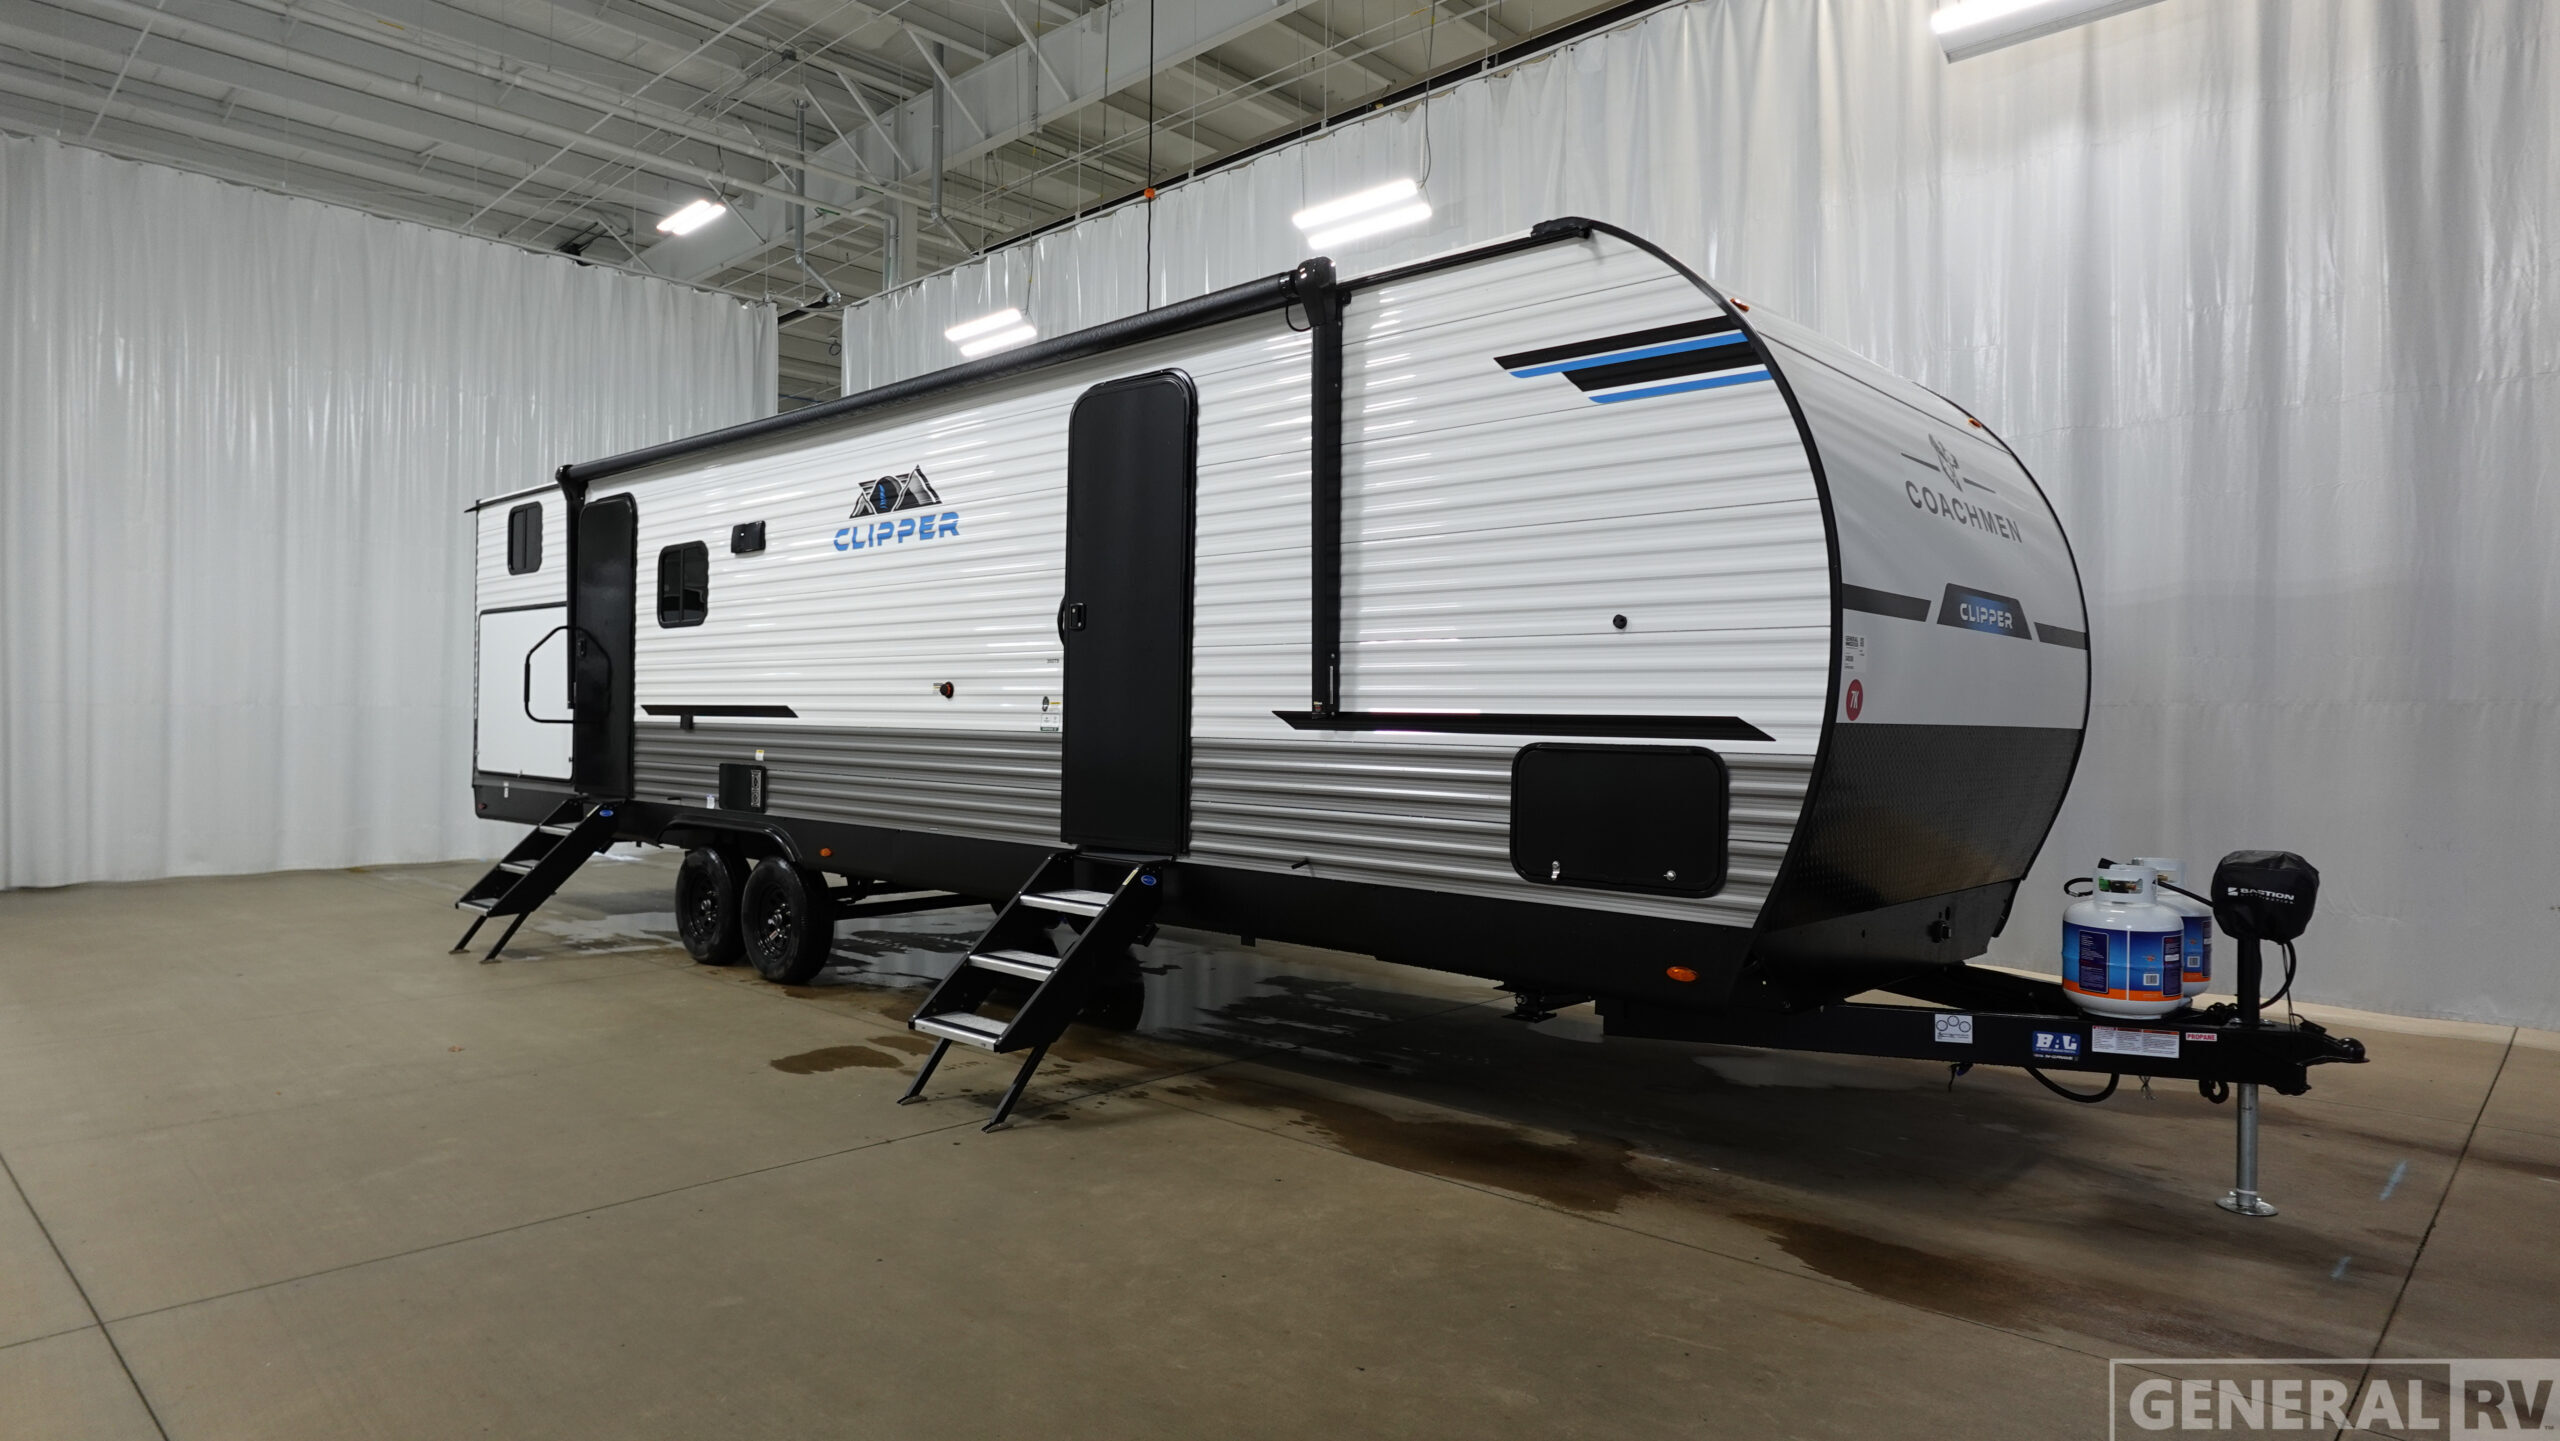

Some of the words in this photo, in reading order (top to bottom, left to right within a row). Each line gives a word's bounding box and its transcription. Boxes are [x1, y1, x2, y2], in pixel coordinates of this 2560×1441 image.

[1905, 480, 2023, 543] COACHMEN
[833, 511, 960, 551] CLIPPER
[1959, 602, 2013, 630] CLIPPER
[2187, 1033, 2215, 1041] PROPANE
